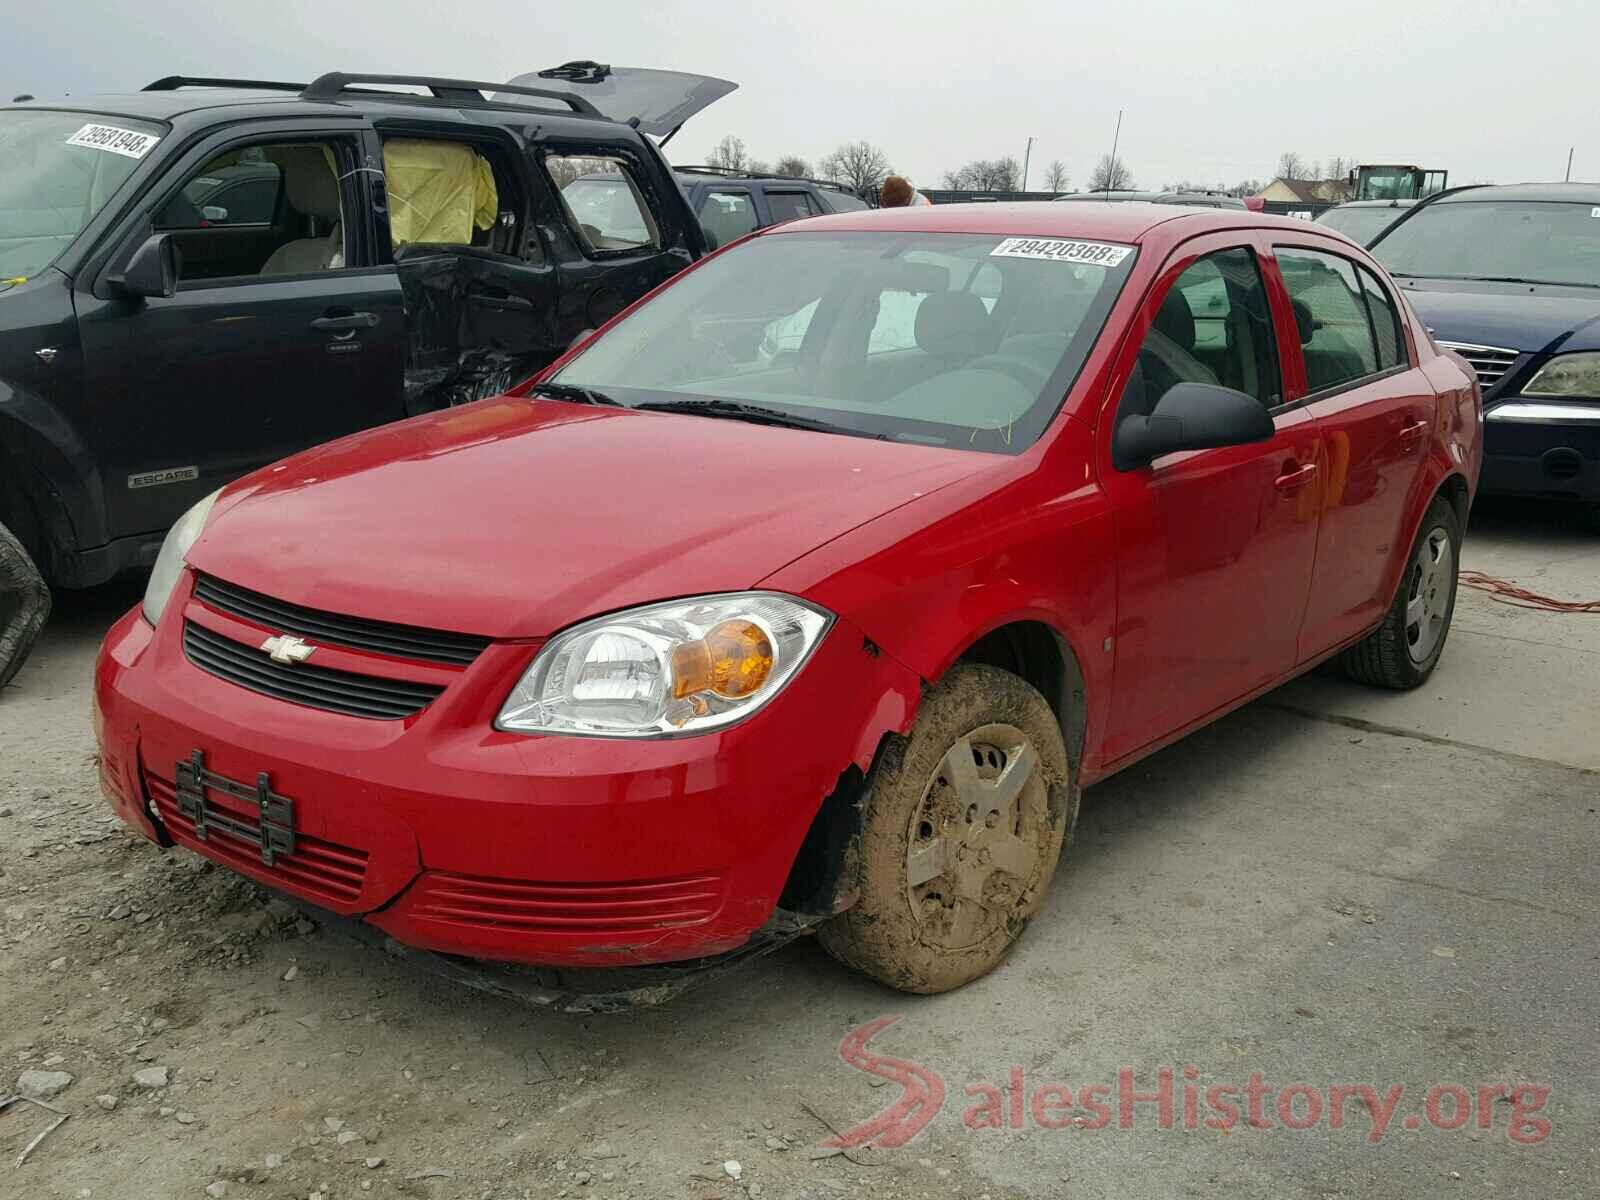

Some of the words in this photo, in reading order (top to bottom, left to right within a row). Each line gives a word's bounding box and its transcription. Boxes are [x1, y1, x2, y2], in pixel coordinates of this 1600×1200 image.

[79, 126, 148, 152] 29581948
[1008, 239, 1113, 261] 29420368
[133, 469, 193, 486] ESCAPE
